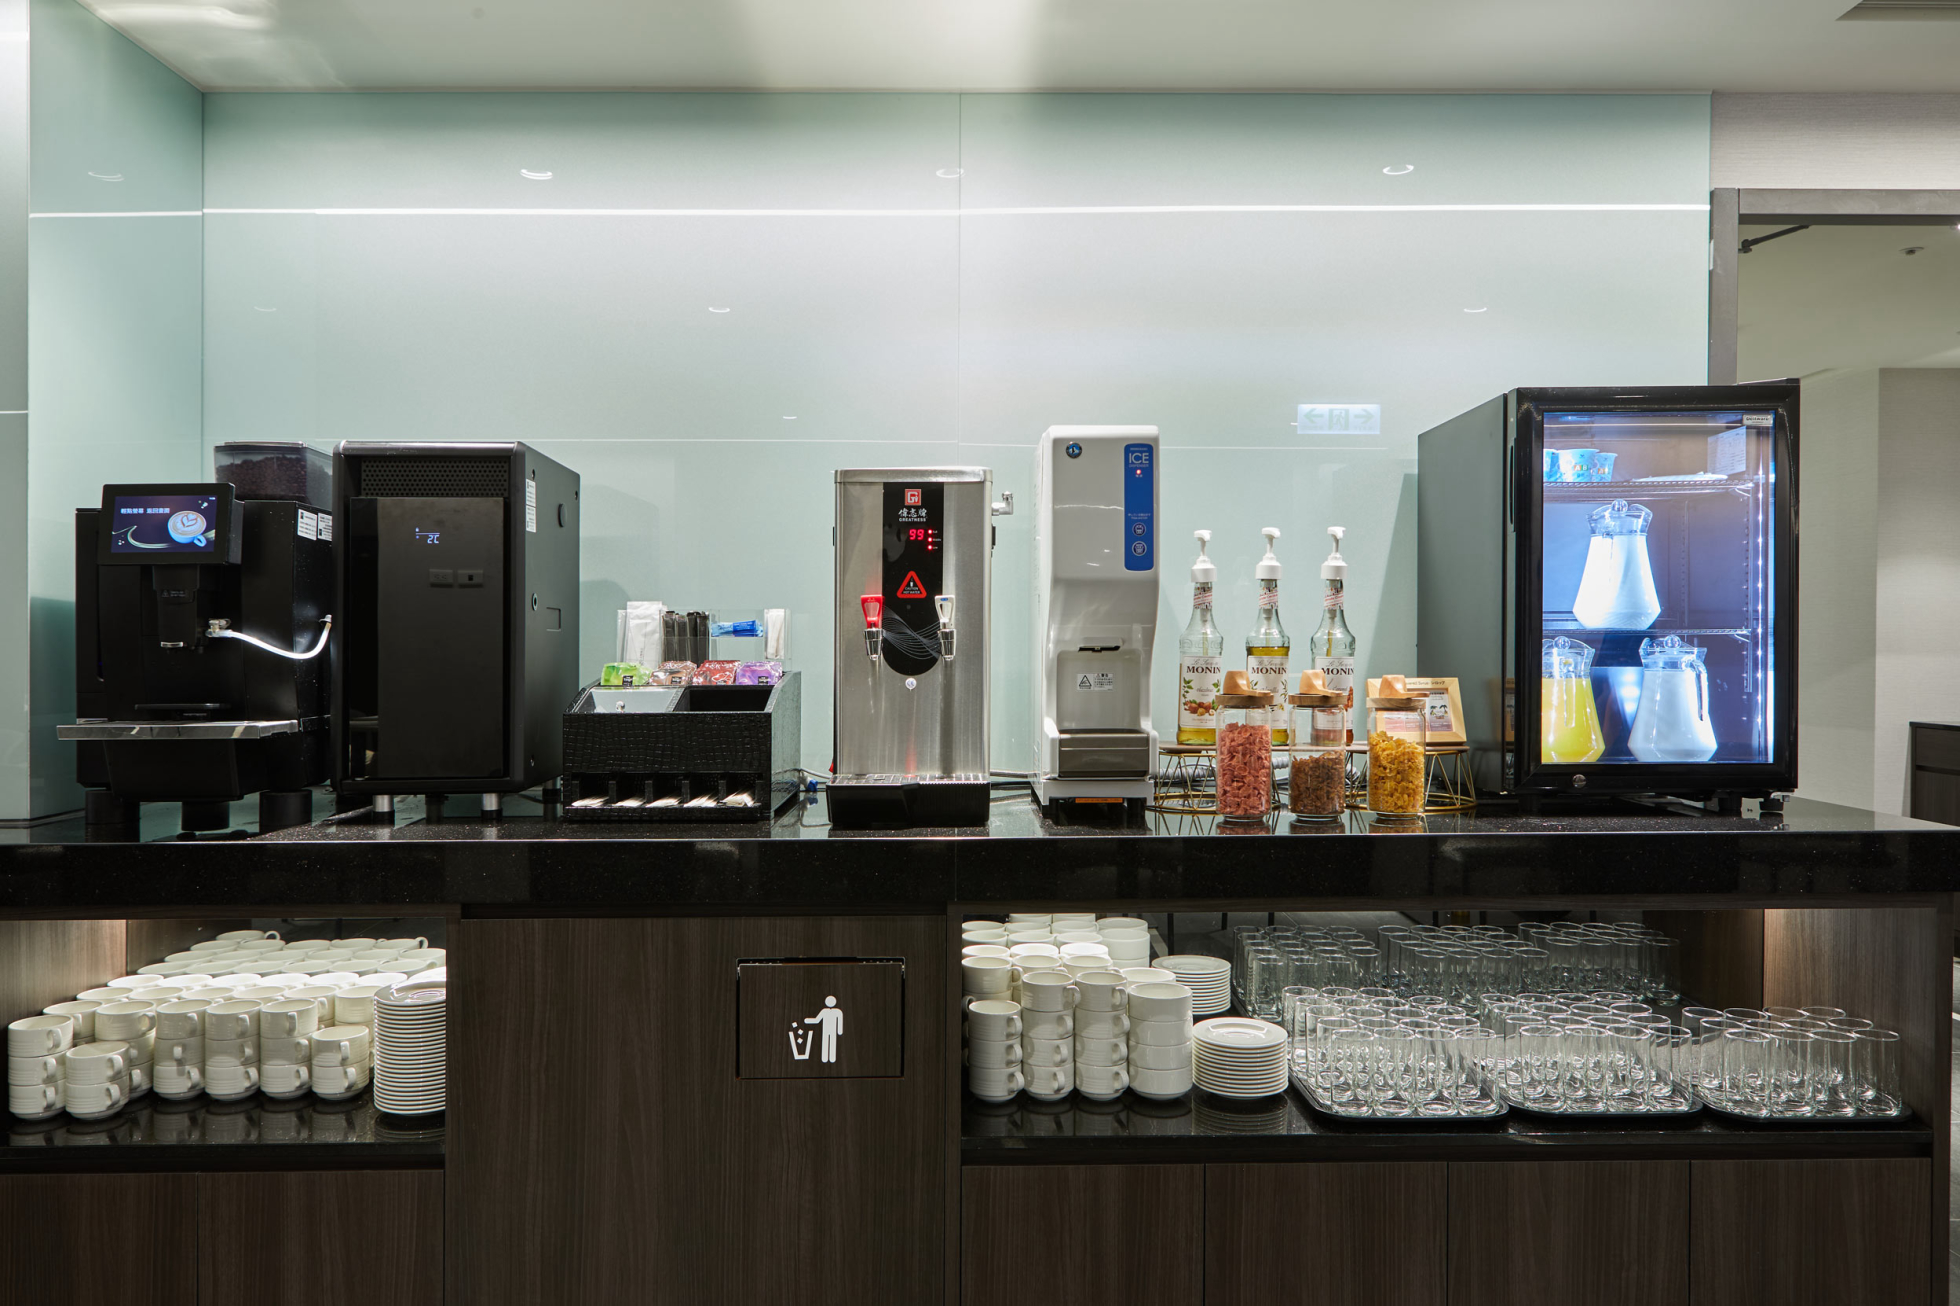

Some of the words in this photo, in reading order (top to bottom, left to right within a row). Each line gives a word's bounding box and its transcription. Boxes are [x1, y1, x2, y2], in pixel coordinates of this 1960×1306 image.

[1129, 453, 1149, 464] ICE
[909, 528, 925, 540] 99
[1186, 666, 1221, 674] MONIN
[1251, 667, 1287, 675] MONIN
